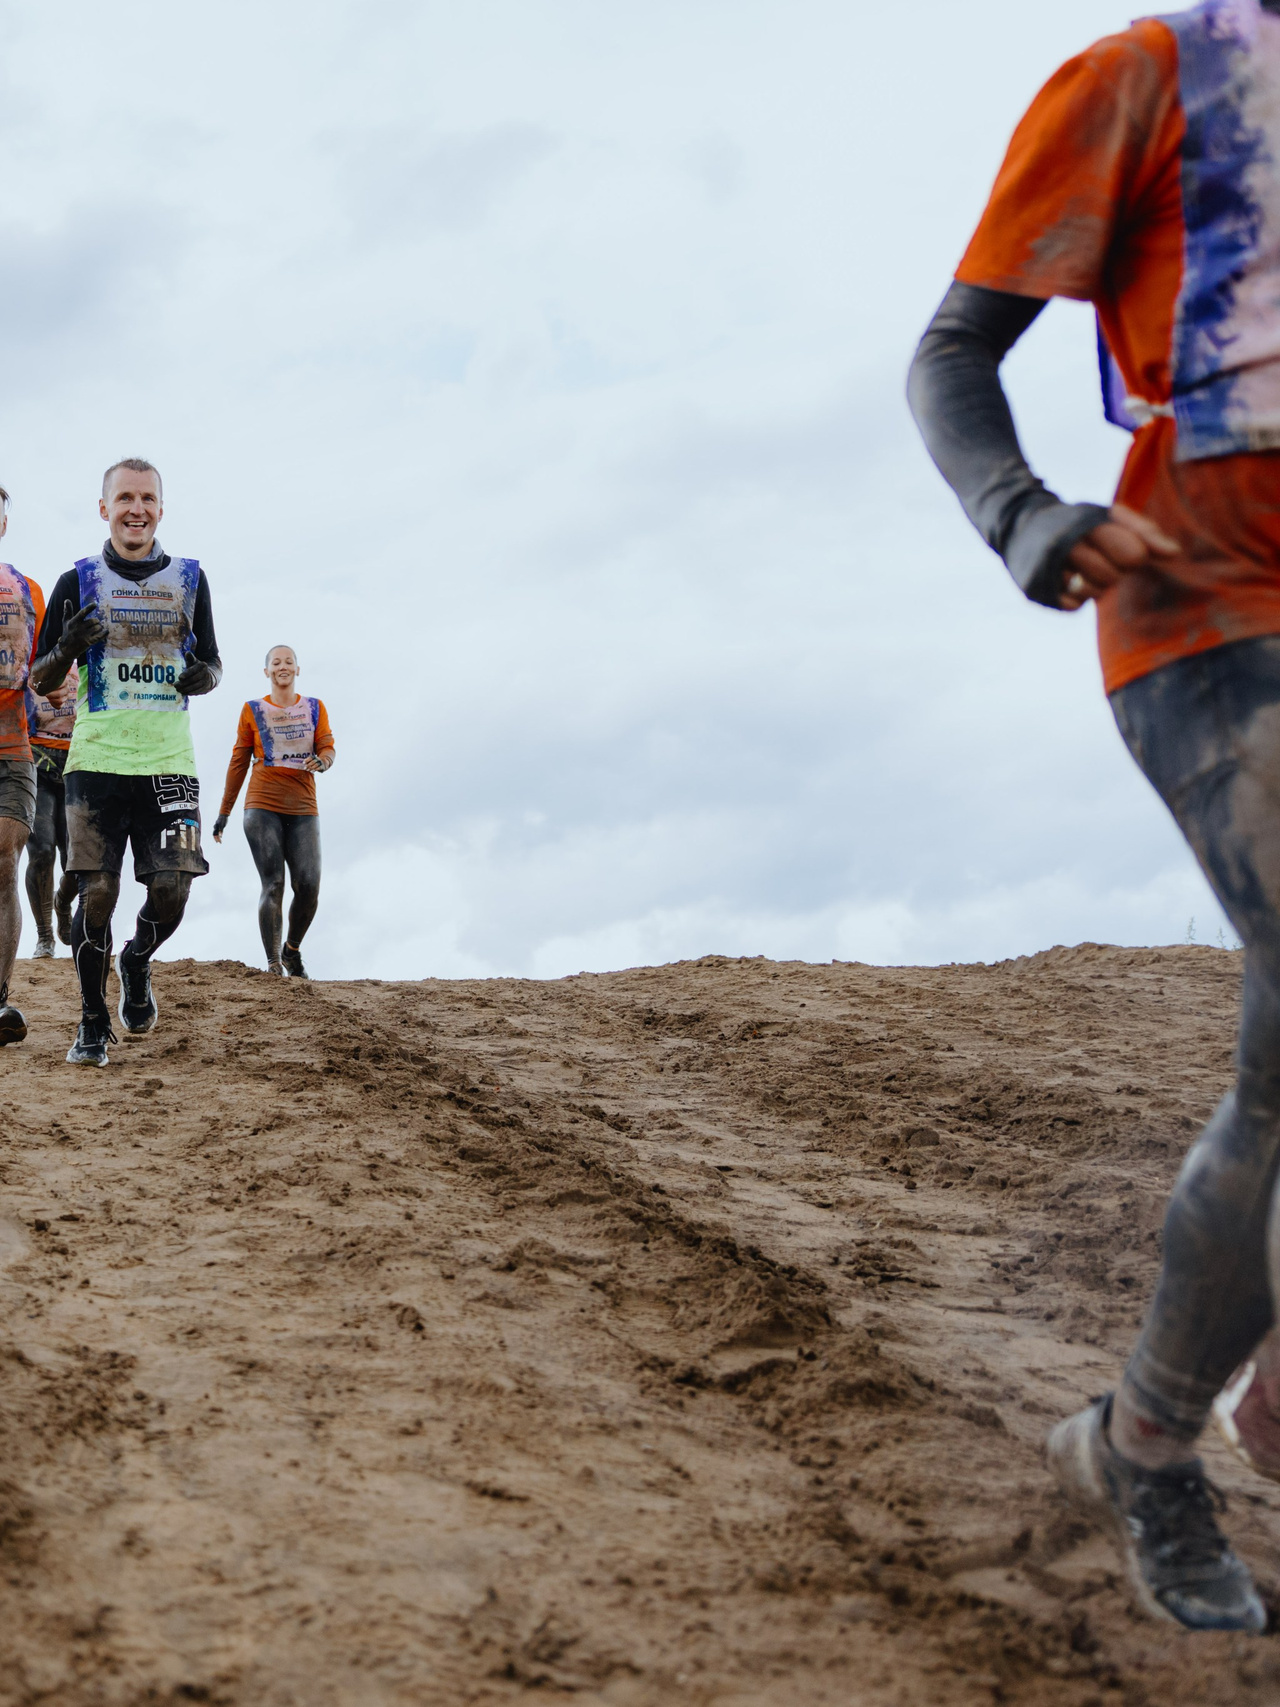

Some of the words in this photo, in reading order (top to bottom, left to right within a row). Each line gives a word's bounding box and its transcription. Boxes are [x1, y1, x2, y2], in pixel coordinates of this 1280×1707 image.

[141, 590, 173, 598] ГЕРОЕВ
[111, 610, 178, 624] КОМАНДНЫЙ
[118, 663, 175, 684] 04008
[133, 693, 177, 701] ГАЗПРОМБАНК
